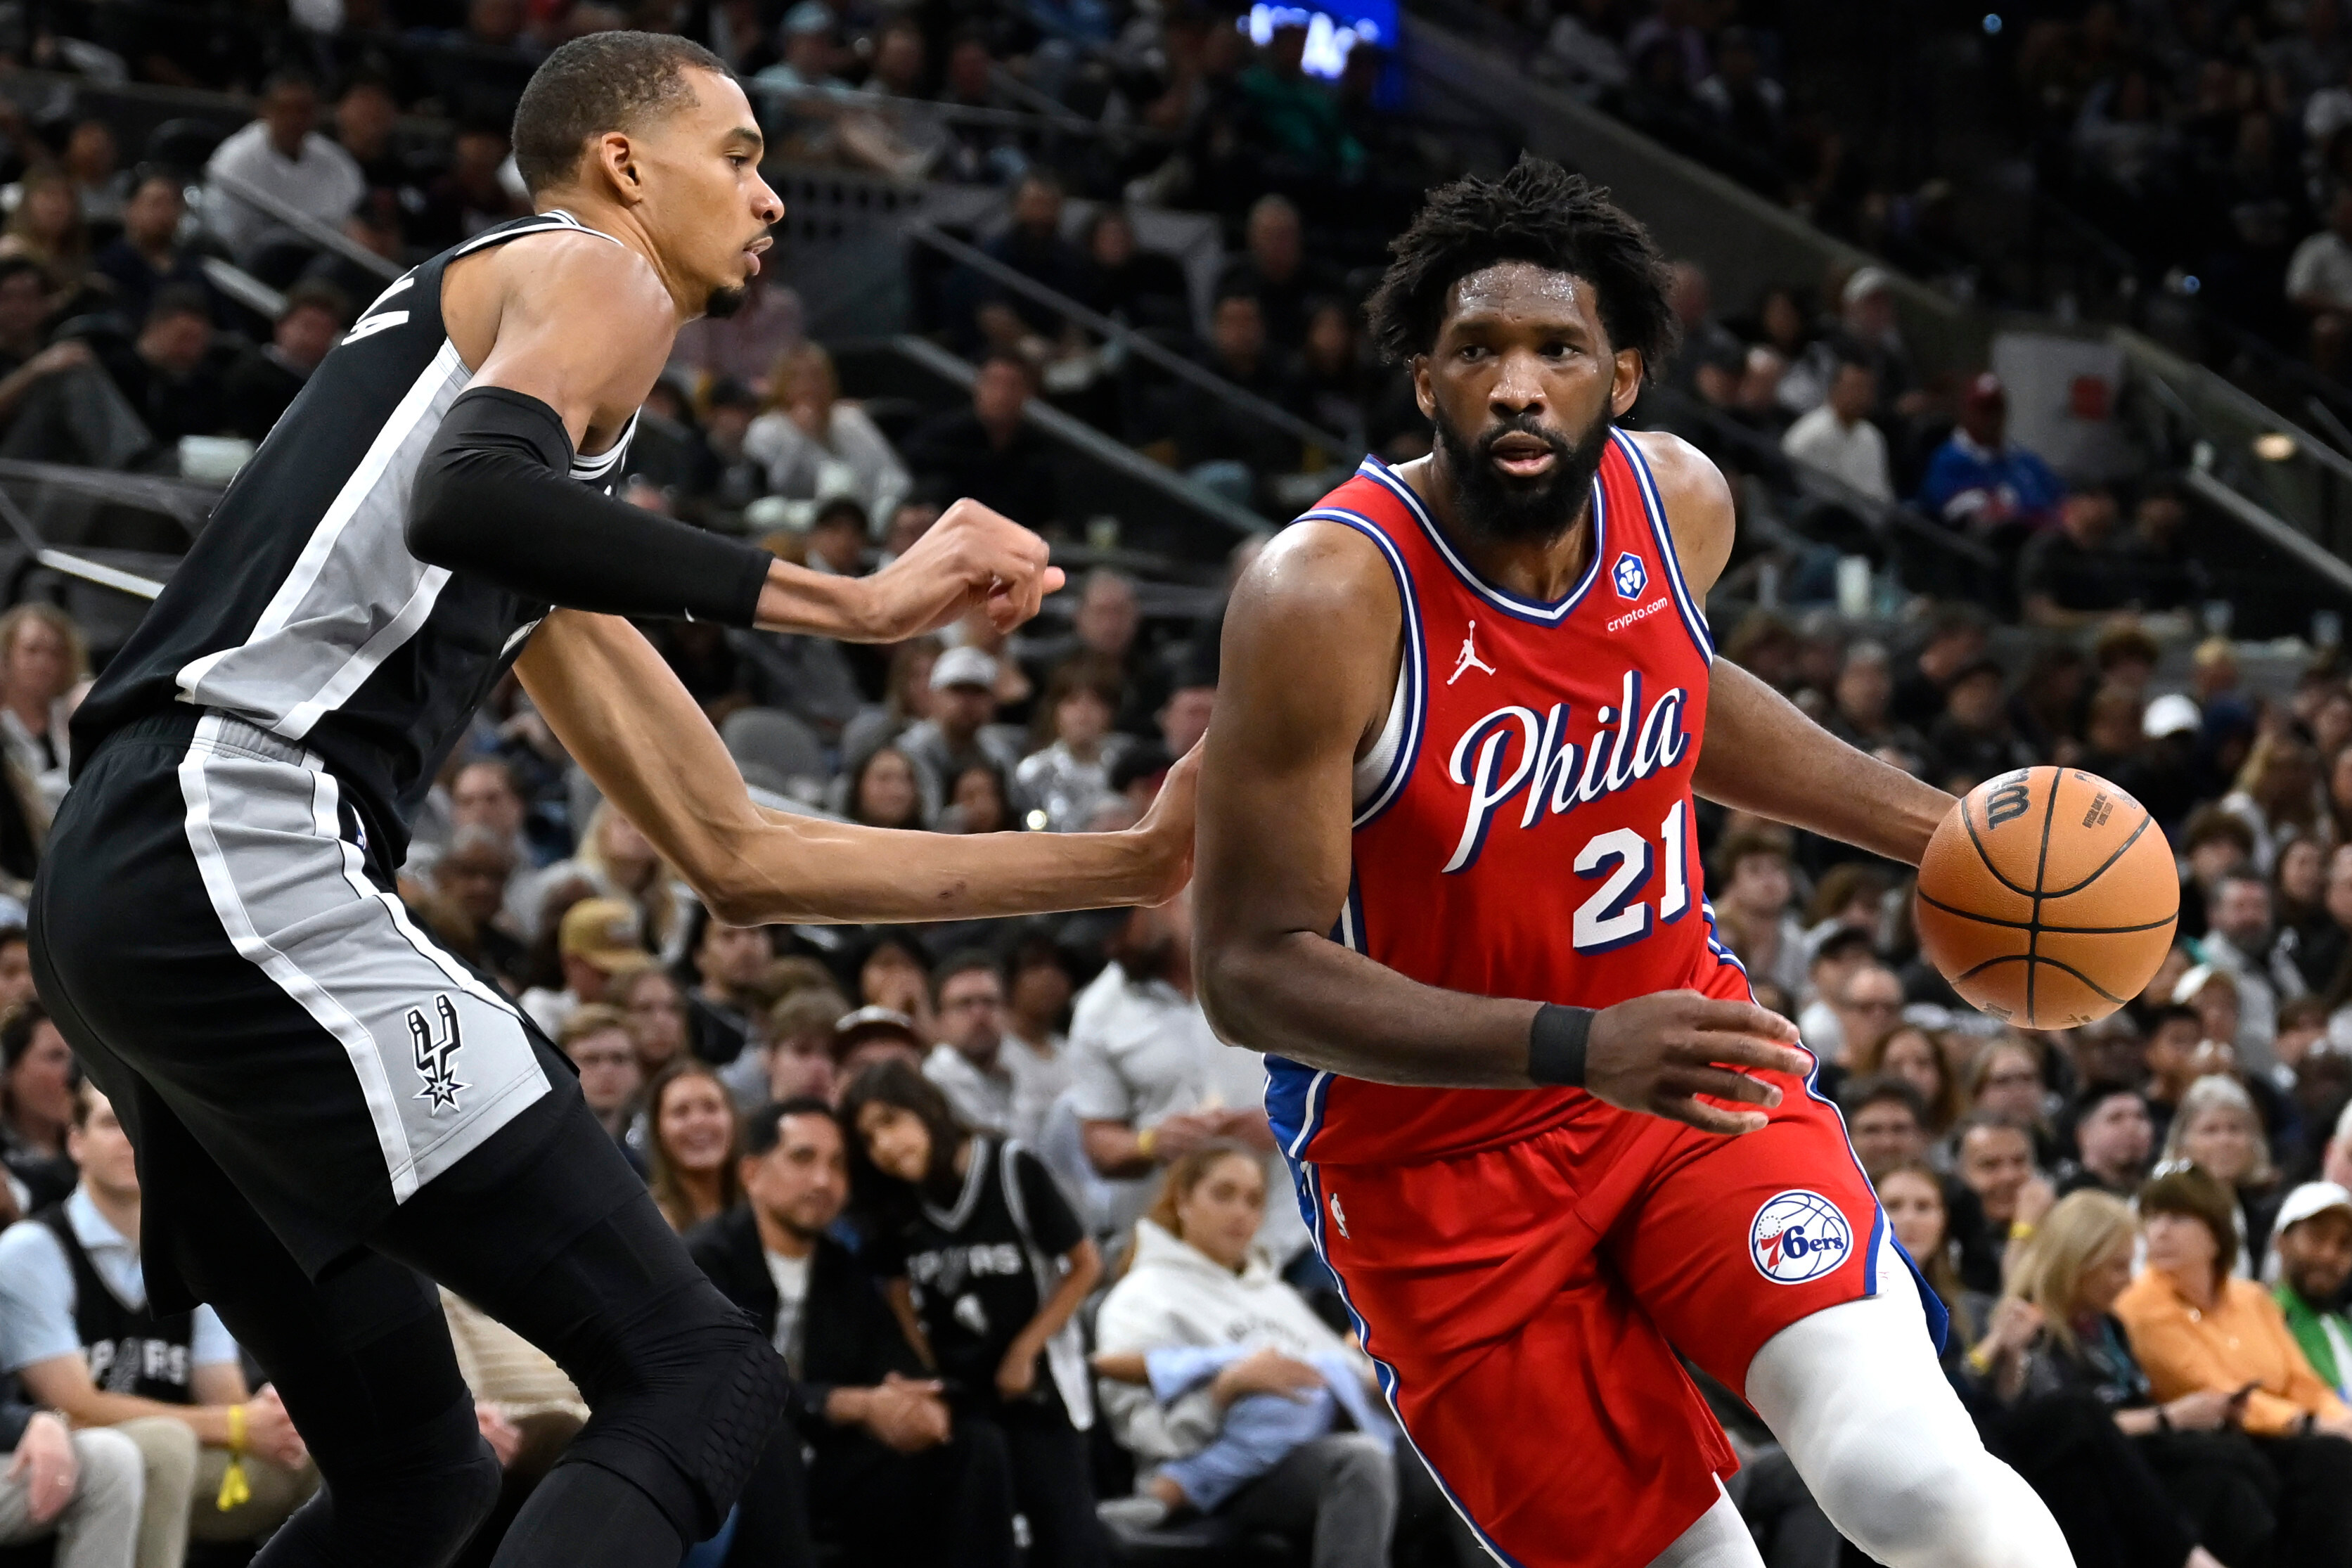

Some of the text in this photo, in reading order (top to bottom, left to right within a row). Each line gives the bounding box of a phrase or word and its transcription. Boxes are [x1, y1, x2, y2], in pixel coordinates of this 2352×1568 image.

[1607, 597, 1668, 632] crypto.com
[1441, 669, 1690, 875] Phila
[1573, 799, 1691, 956] 21
[1759, 1225, 1844, 1271] 76ers
